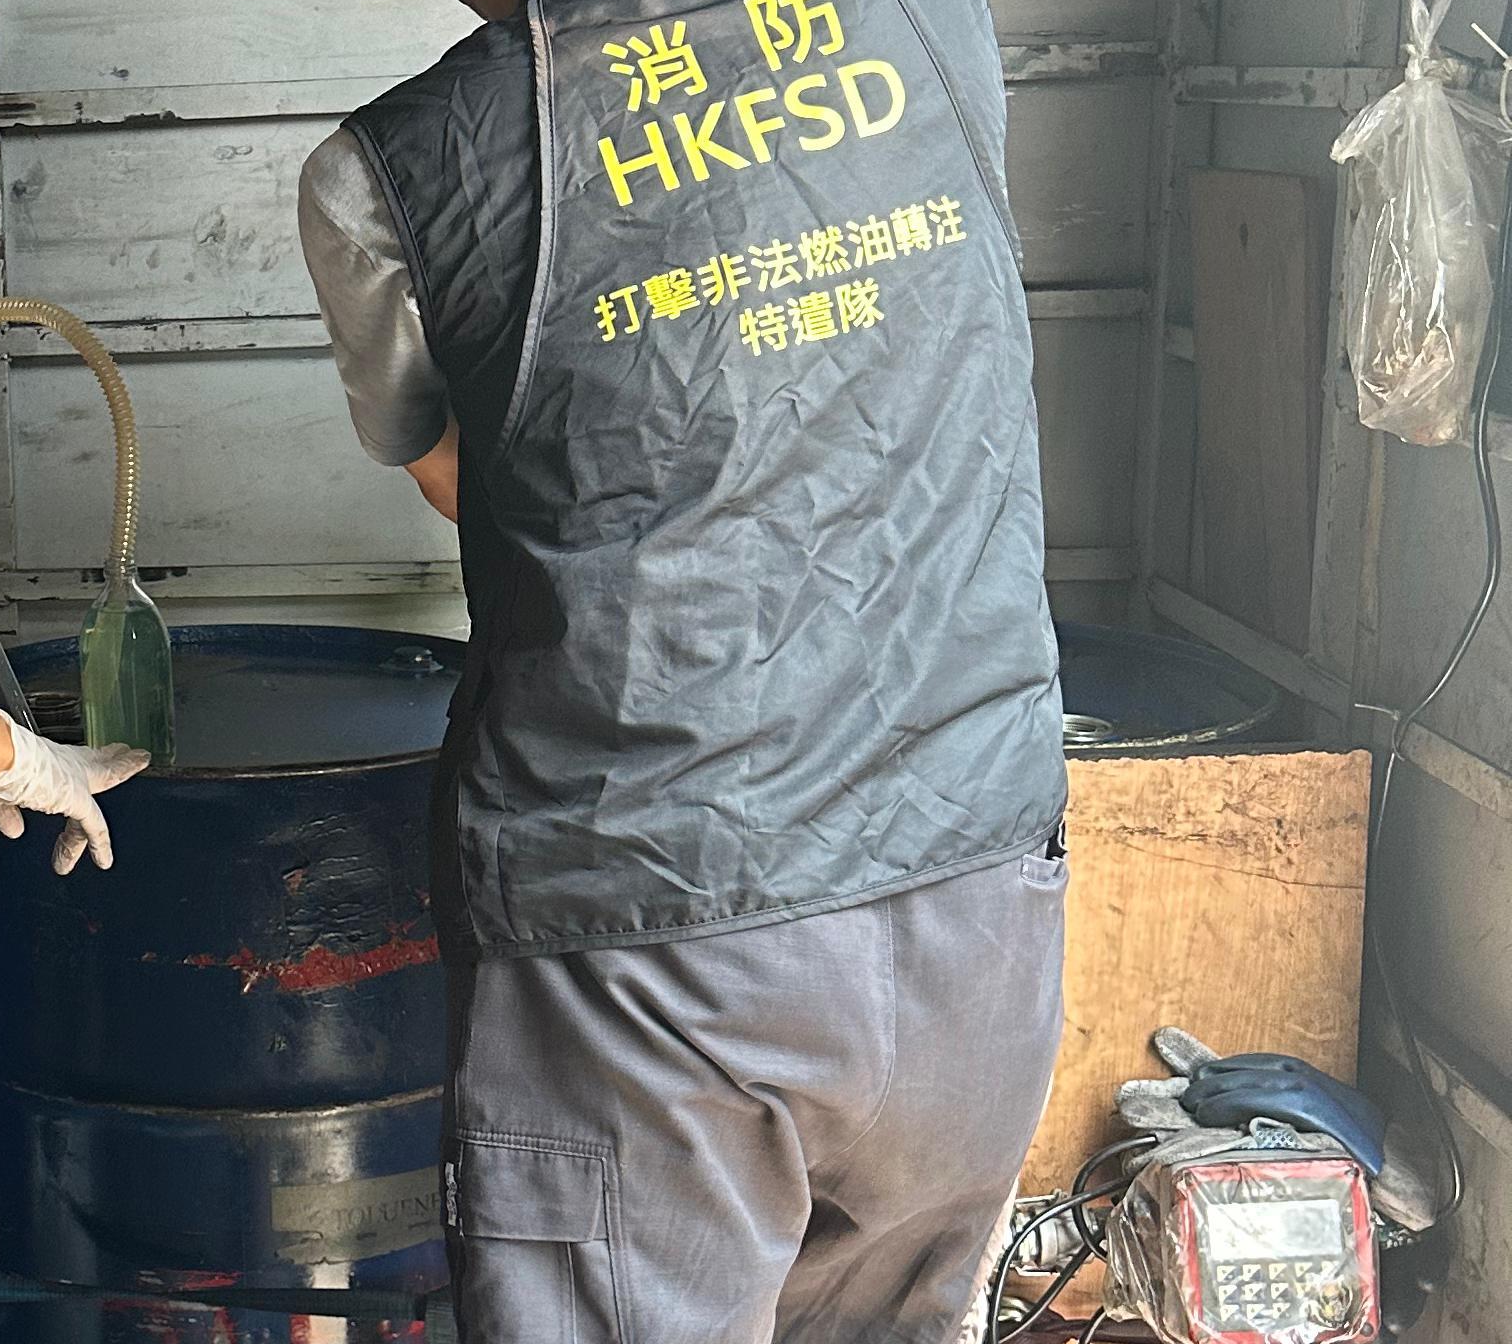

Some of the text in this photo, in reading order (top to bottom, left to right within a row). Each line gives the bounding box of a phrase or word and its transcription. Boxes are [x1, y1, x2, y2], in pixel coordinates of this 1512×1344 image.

[597, 60, 907, 207] HKFSD
[593, 195, 968, 343] 打擊非法燃油轉注
[739, 278, 885, 357] 特遣隊
